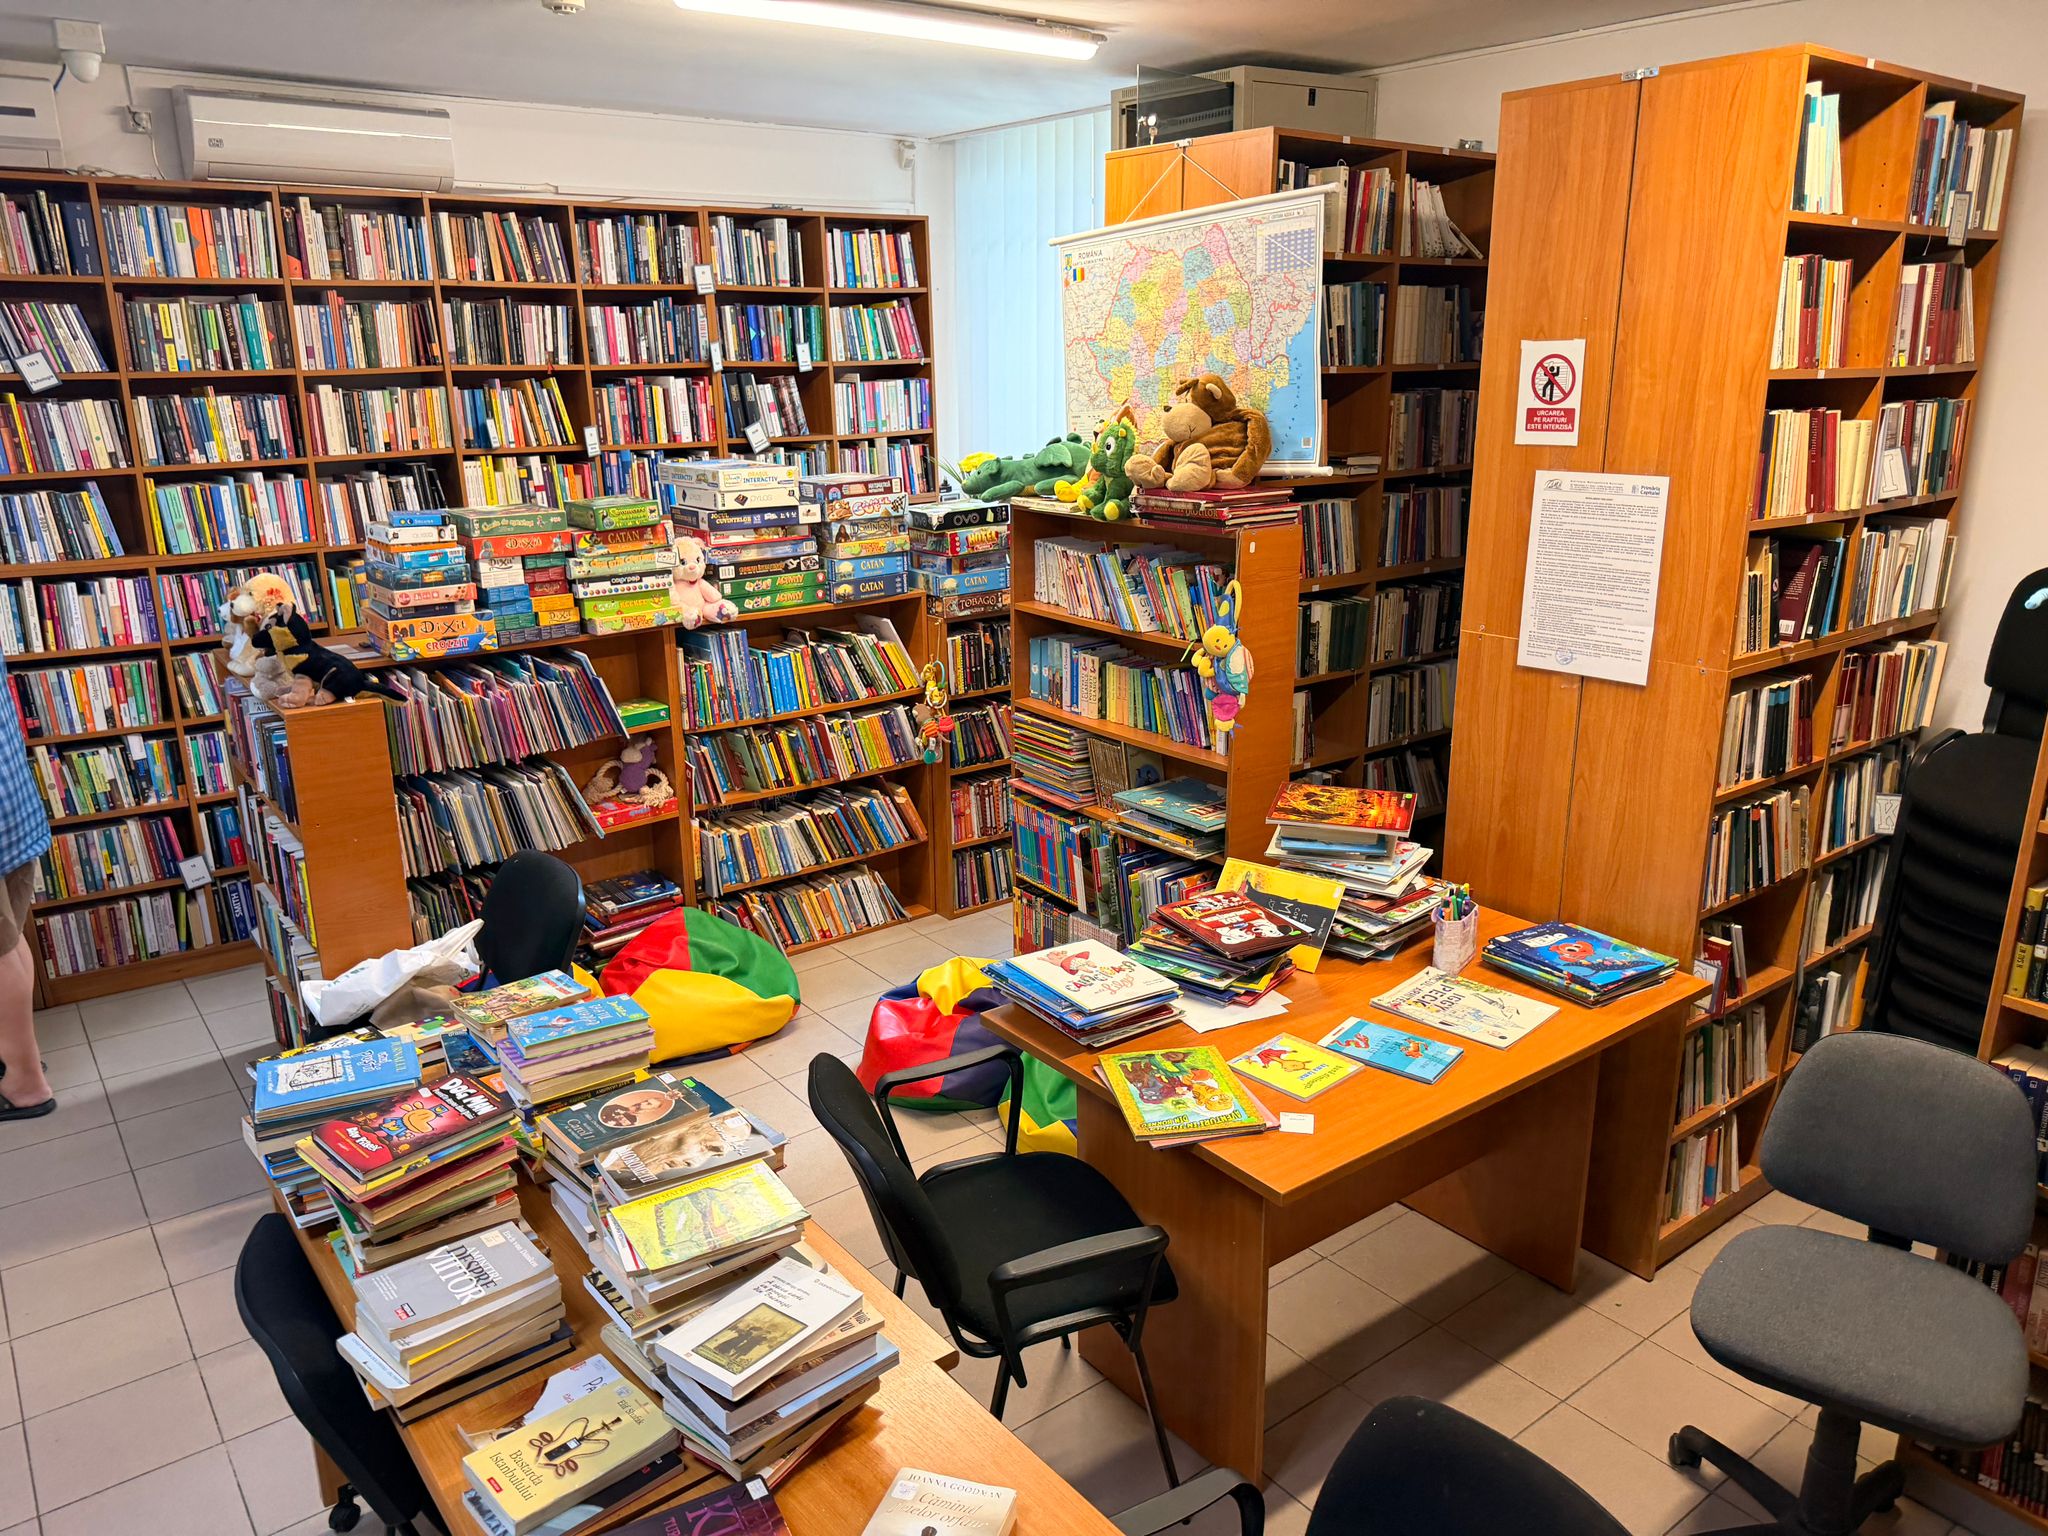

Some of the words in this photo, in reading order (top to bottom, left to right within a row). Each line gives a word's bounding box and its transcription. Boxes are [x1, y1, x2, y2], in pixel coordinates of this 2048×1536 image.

[953, 512, 980, 526] OVO
[608, 530, 640, 544] CATAN
[968, 531, 998, 546] HOTEL
[861, 559, 885, 570] CATAN
[860, 581, 884, 592] CATAN
[964, 576, 988, 587] CATAN
[960, 595, 997, 610] TOBAGO
[426, 638, 469, 650] CROZZIT
[230, 891, 242, 918] SMITH
[1420, 984, 1455, 1010] PECK
[1434, 992, 1467, 1013] IGGY
[440, 1077, 469, 1103] DOG
[461, 1093, 498, 1118] MAN
[1174, 1114, 1189, 1123] DIN
[1198, 1110, 1243, 1126] AVENTURI
[566, 1117, 590, 1138] Carol
[425, 1246, 487, 1305] VIITOR
[449, 1244, 498, 1290] DESPRE
[616, 1399, 629, 1412] Elif
[488, 1451, 537, 1502] Istanbulului
[508, 1449, 543, 1487] Bastarda
[907, 1472, 949, 1489] JOANNA
[949, 1479, 1004, 1499] GOODMAN
[918, 1490, 984, 1516] Căminul
